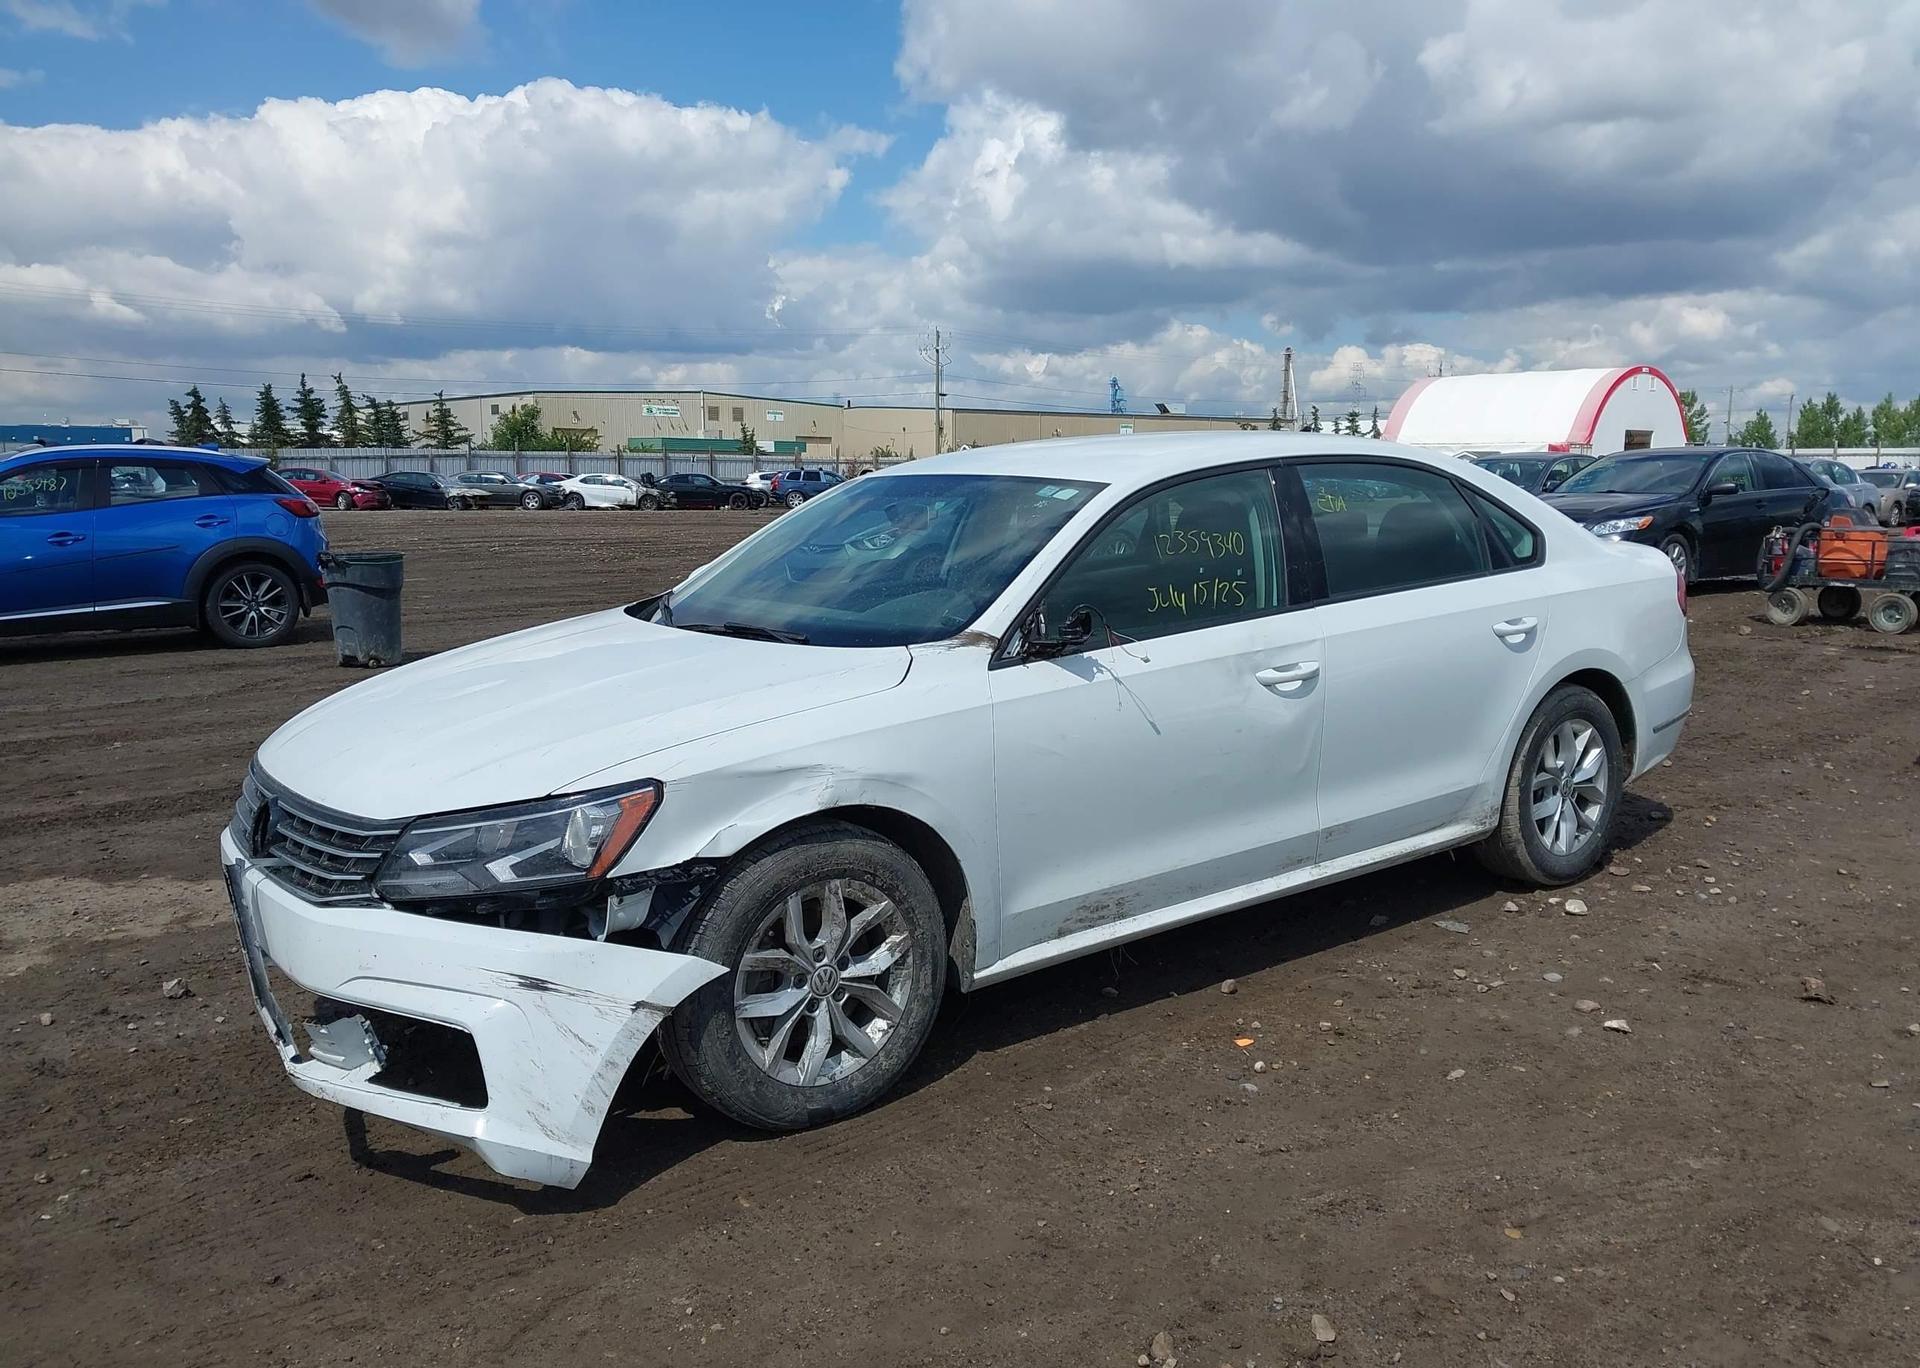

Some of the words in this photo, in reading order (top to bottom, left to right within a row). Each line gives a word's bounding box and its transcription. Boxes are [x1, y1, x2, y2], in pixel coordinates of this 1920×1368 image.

[1154, 529, 1245, 559] 12359340
[1147, 583, 1187, 616] July
[1193, 577, 1248, 610] 15/25
